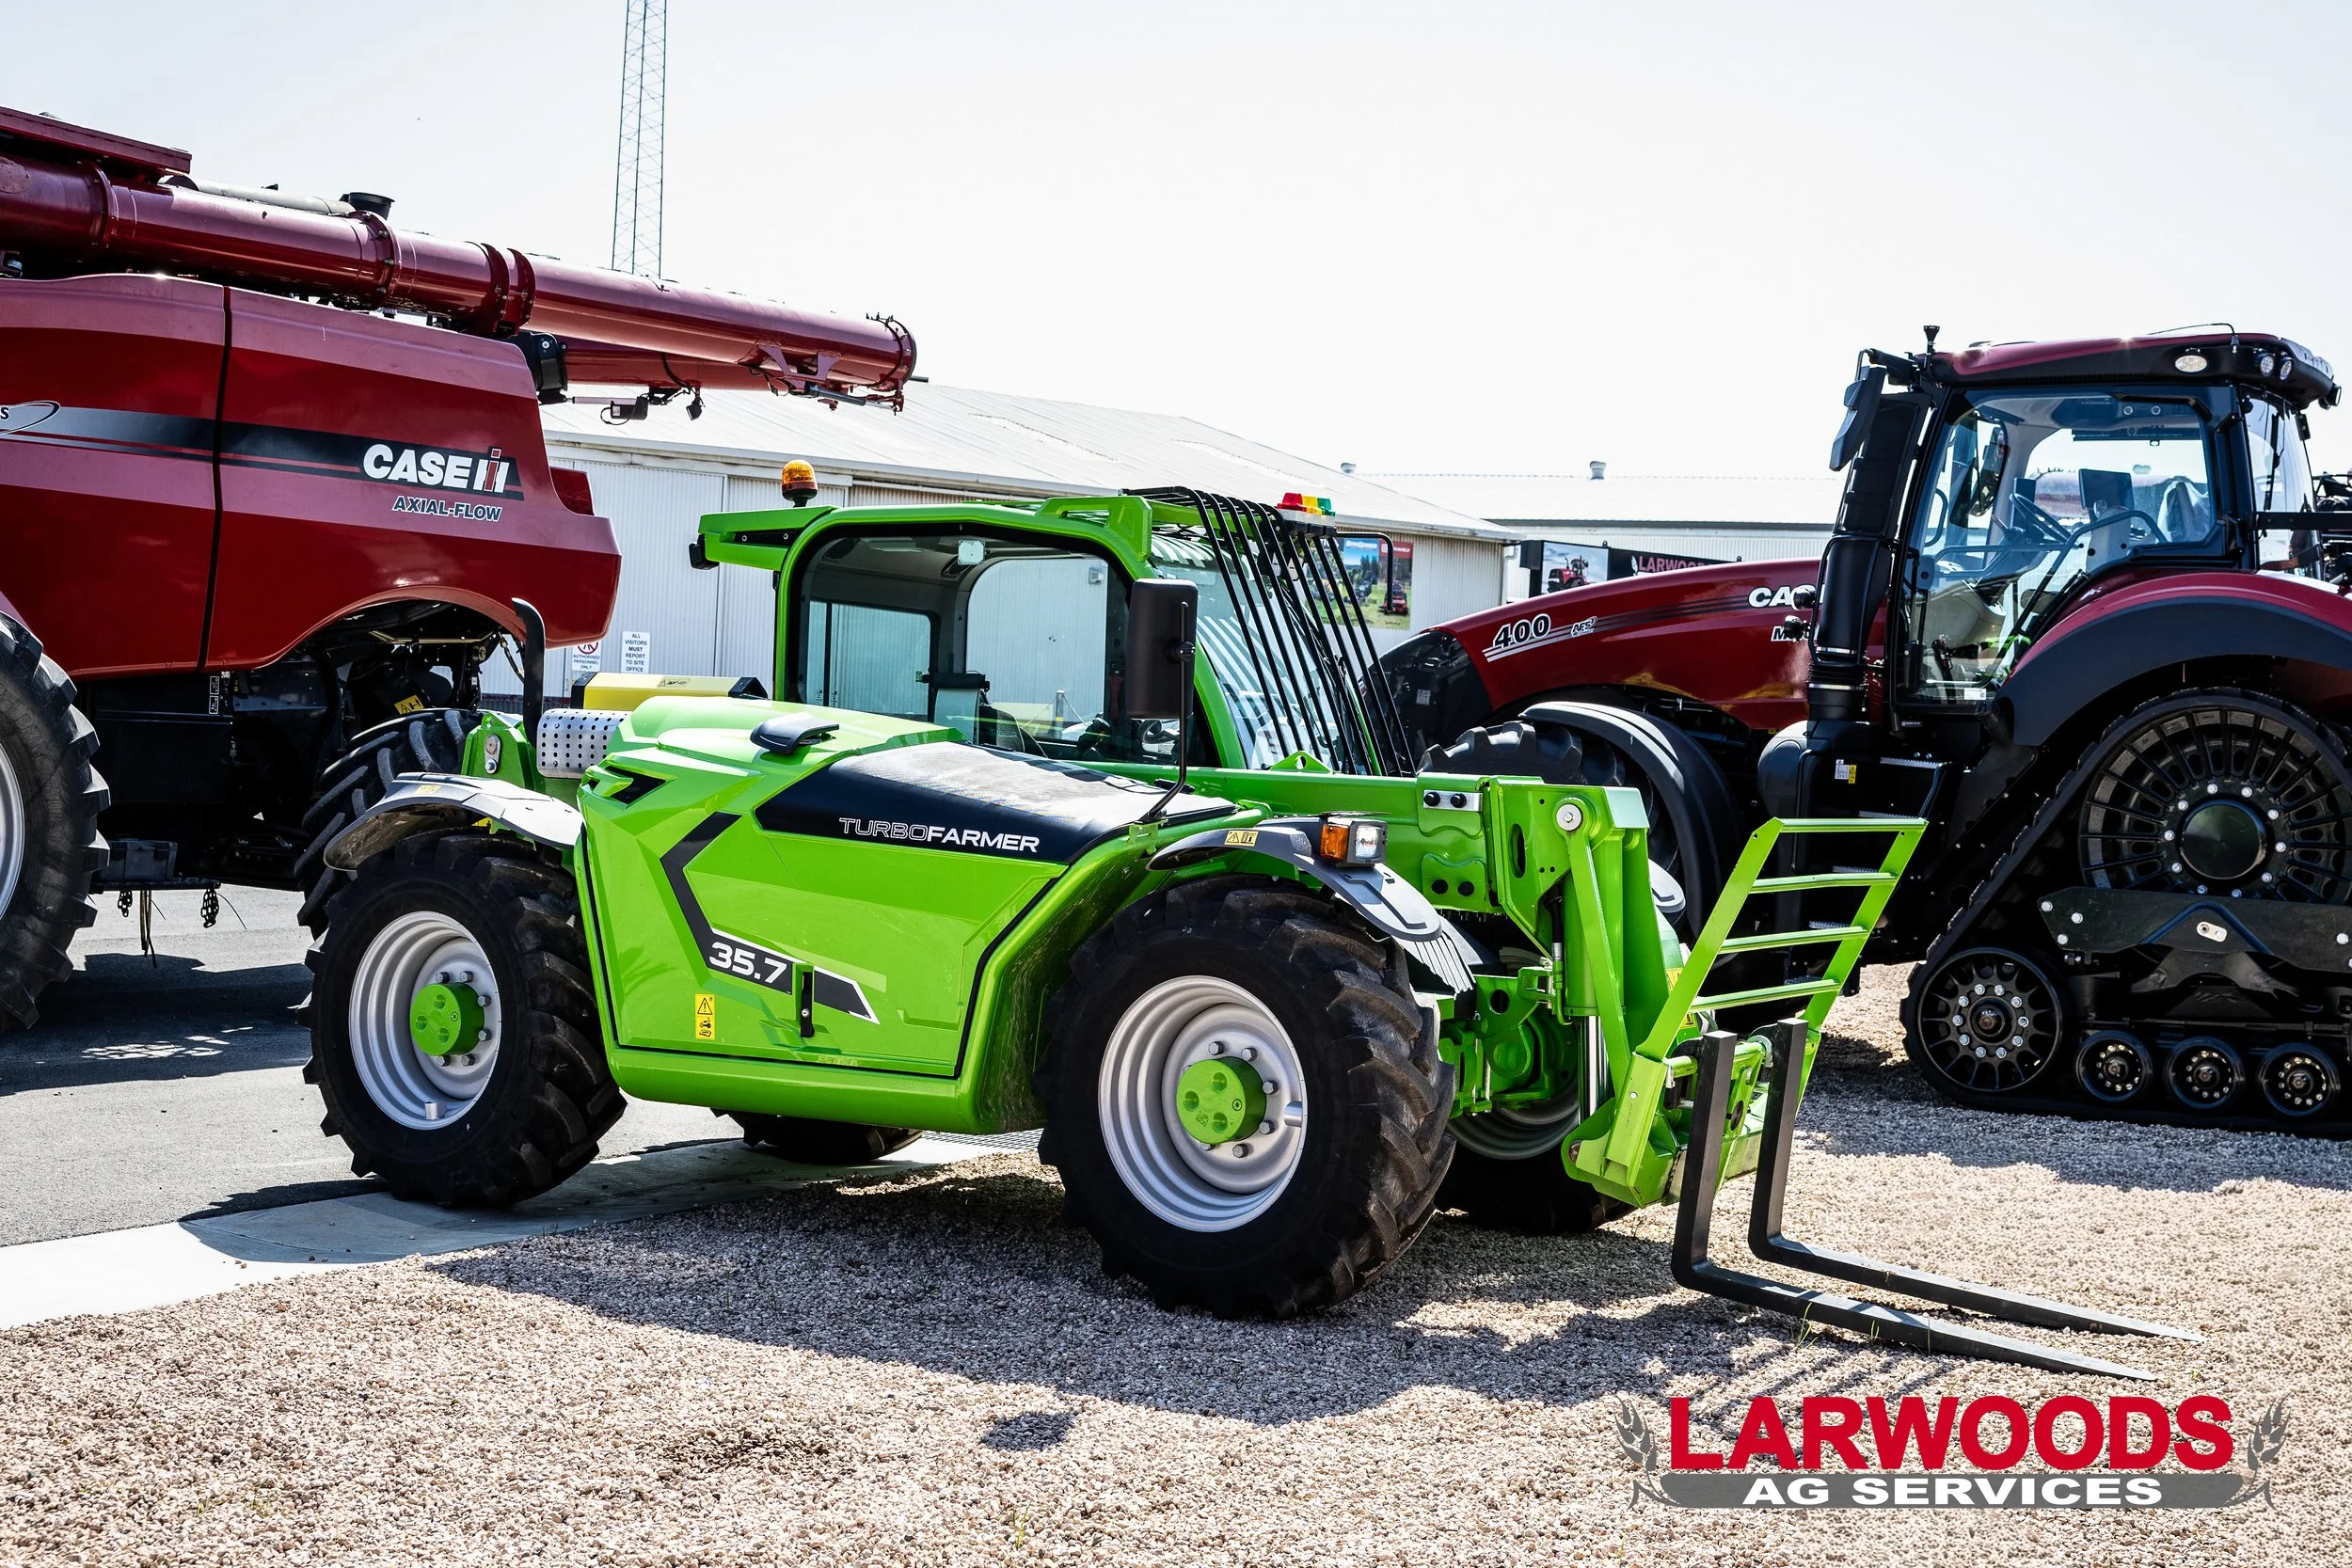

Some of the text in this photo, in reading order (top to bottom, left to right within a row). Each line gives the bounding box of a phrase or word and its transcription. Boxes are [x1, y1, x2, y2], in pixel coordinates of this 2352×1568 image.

[363, 444, 472, 489] CASE
[391, 495, 502, 522] AXIAL-FLOW
[1493, 613, 1551, 649] 400
[1571, 619, 1592, 634] AFS
[839, 817, 1040, 853] TURBOFARMER
[708, 942, 787, 984] 35.7
